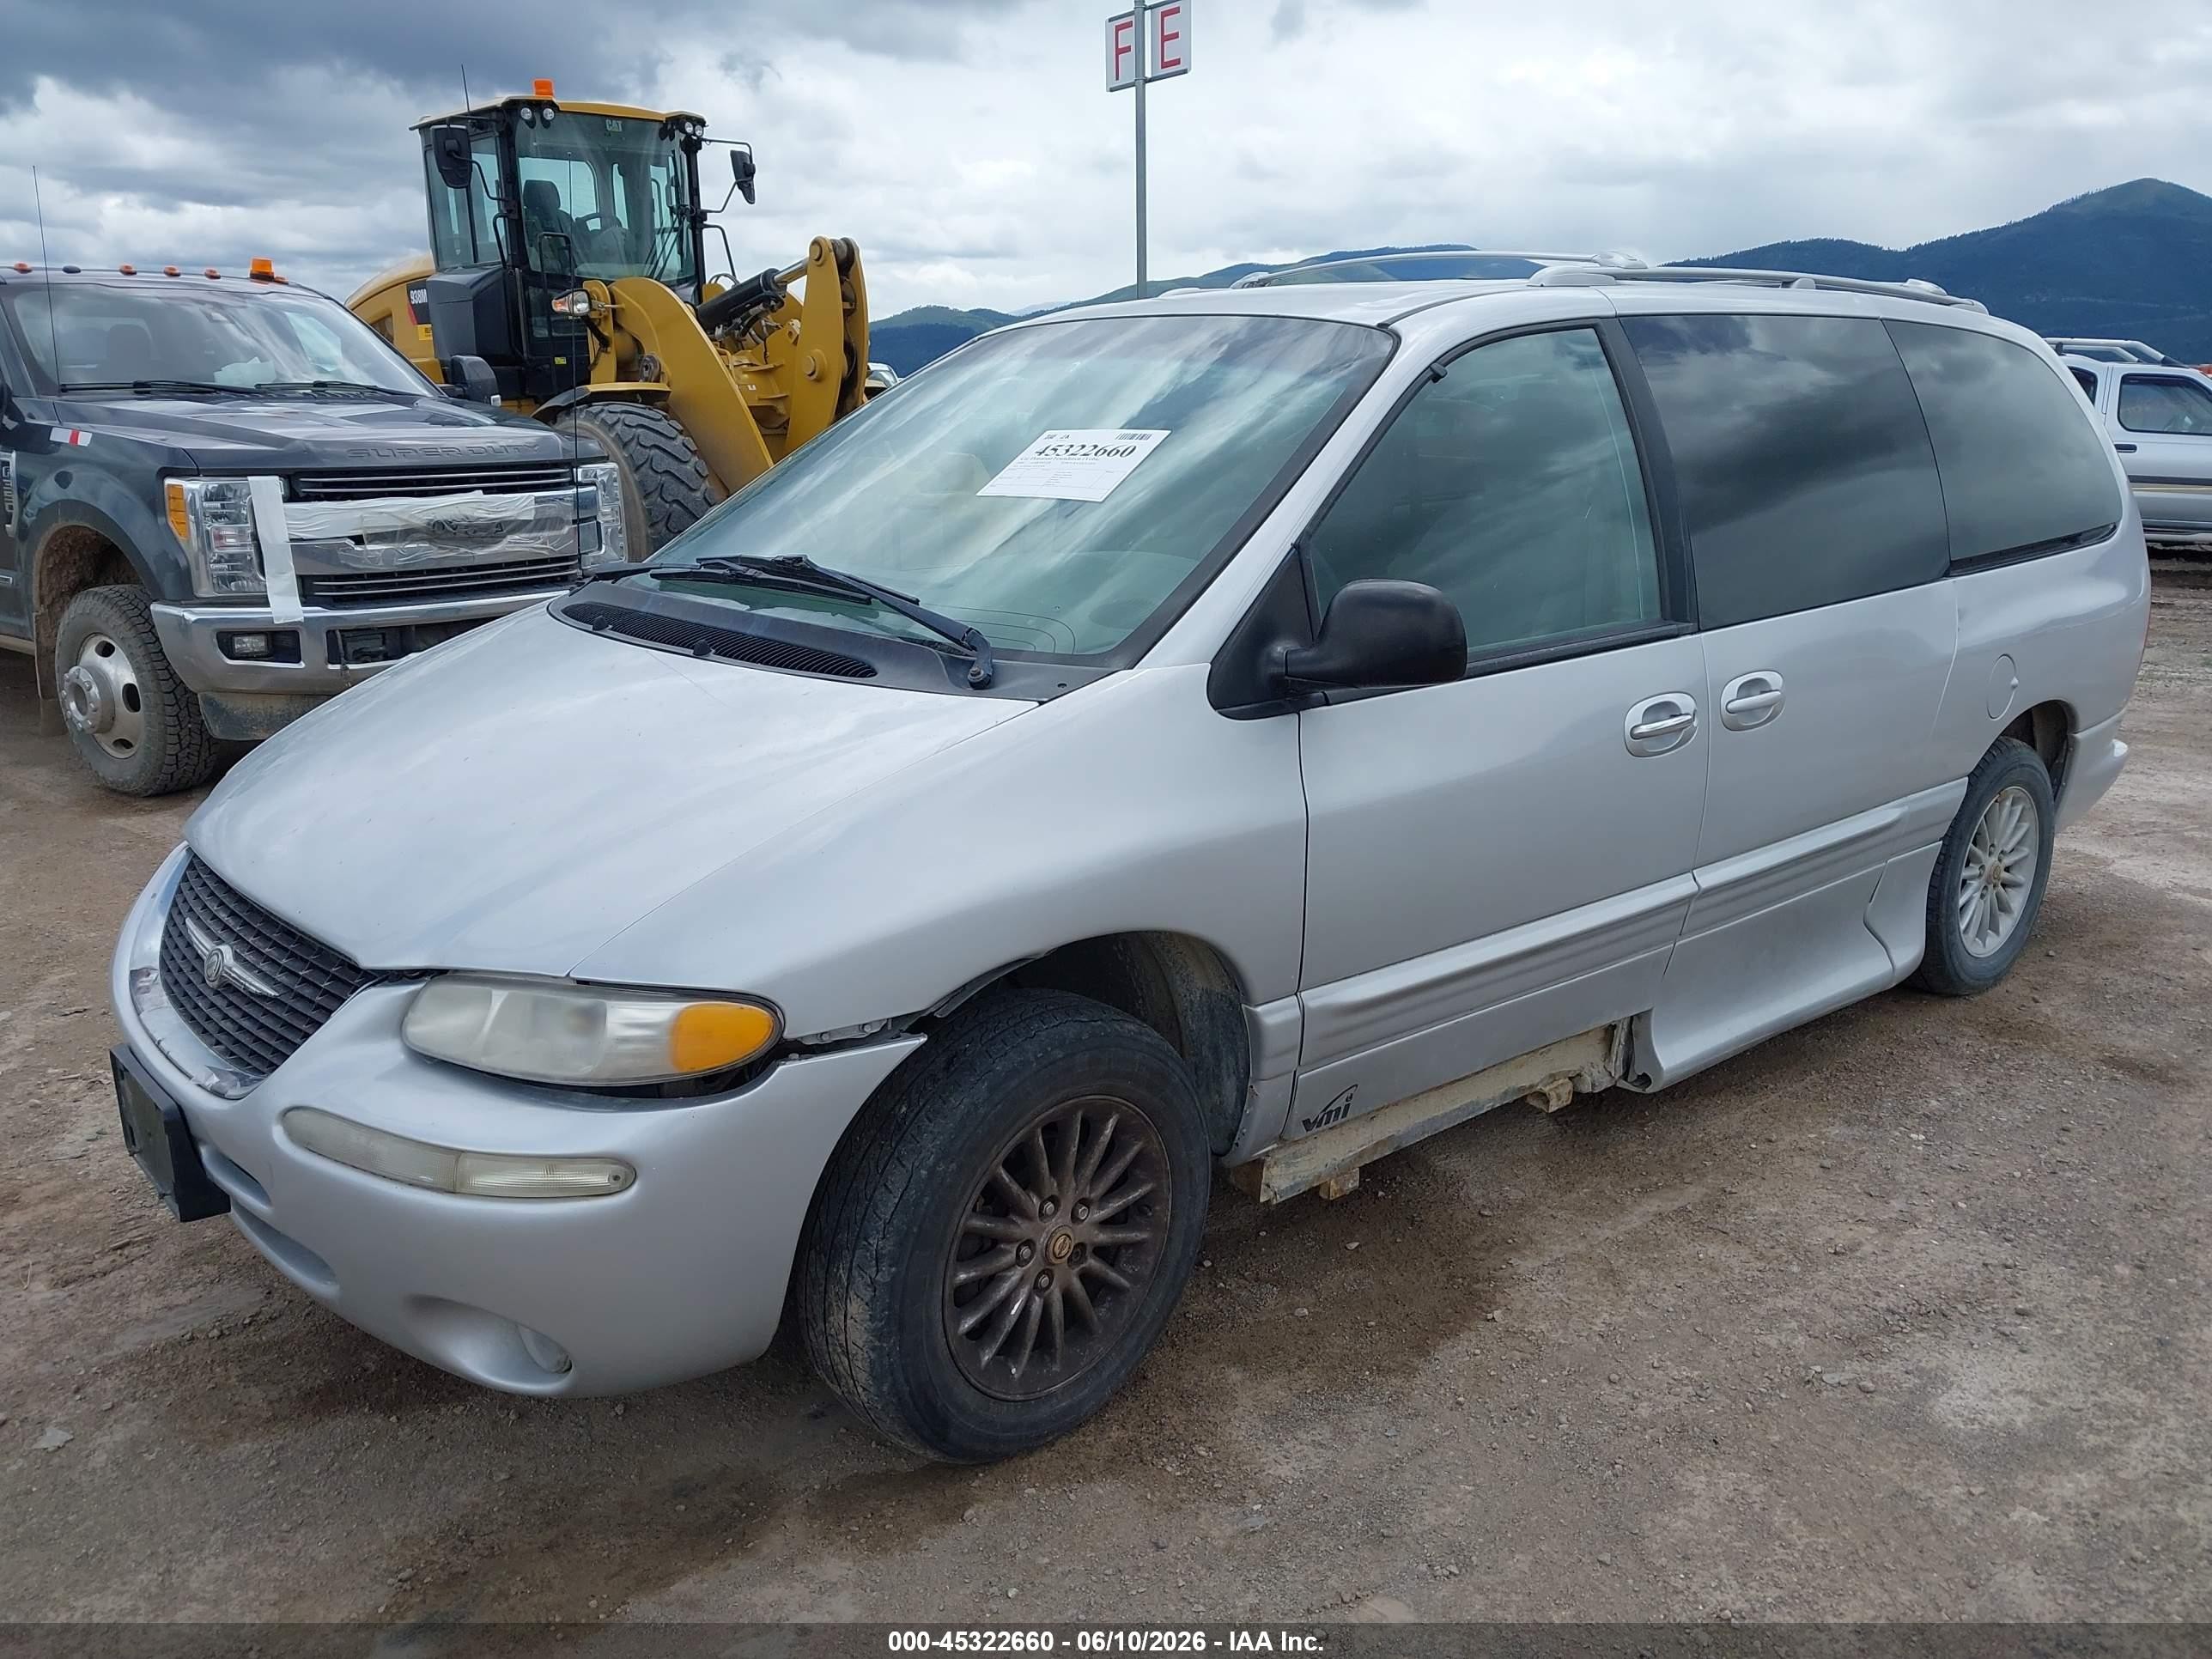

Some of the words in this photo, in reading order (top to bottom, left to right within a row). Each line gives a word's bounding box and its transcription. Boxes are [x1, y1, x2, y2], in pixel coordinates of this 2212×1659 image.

[1160, 6, 1181, 69] E
[1115, 20, 1133, 81] F
[605, 118, 623, 132] CAT
[410, 289, 428, 304] 938M
[346, 447, 462, 458] SUPER
[466, 443, 539, 455] DUTY
[1035, 444, 1137, 458] 45322660
